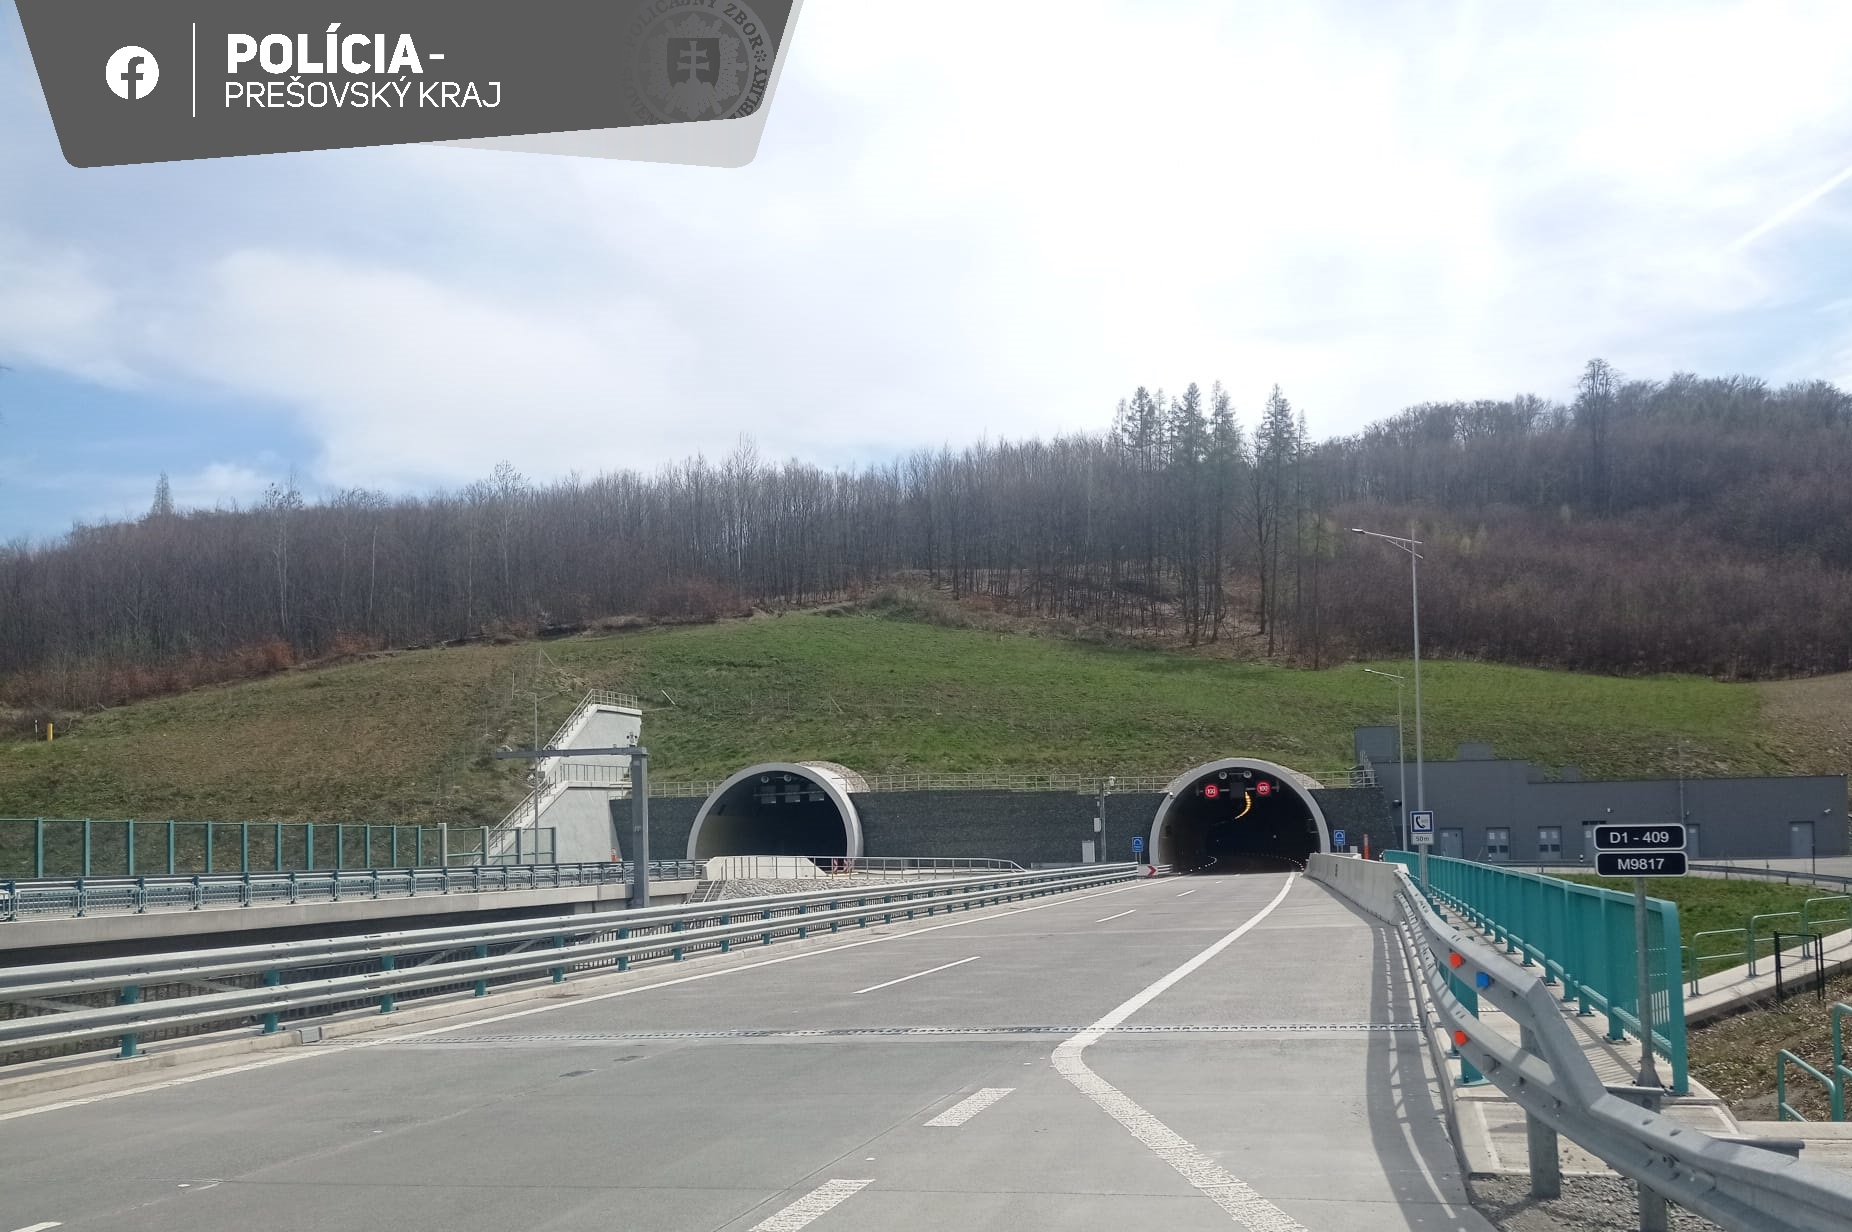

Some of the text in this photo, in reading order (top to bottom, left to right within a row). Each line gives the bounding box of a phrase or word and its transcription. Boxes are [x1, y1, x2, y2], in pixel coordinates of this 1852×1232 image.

[1609, 831, 1628, 844] D1
[1642, 831, 1670, 843] 409
[1617, 858, 1665, 870] M9817
